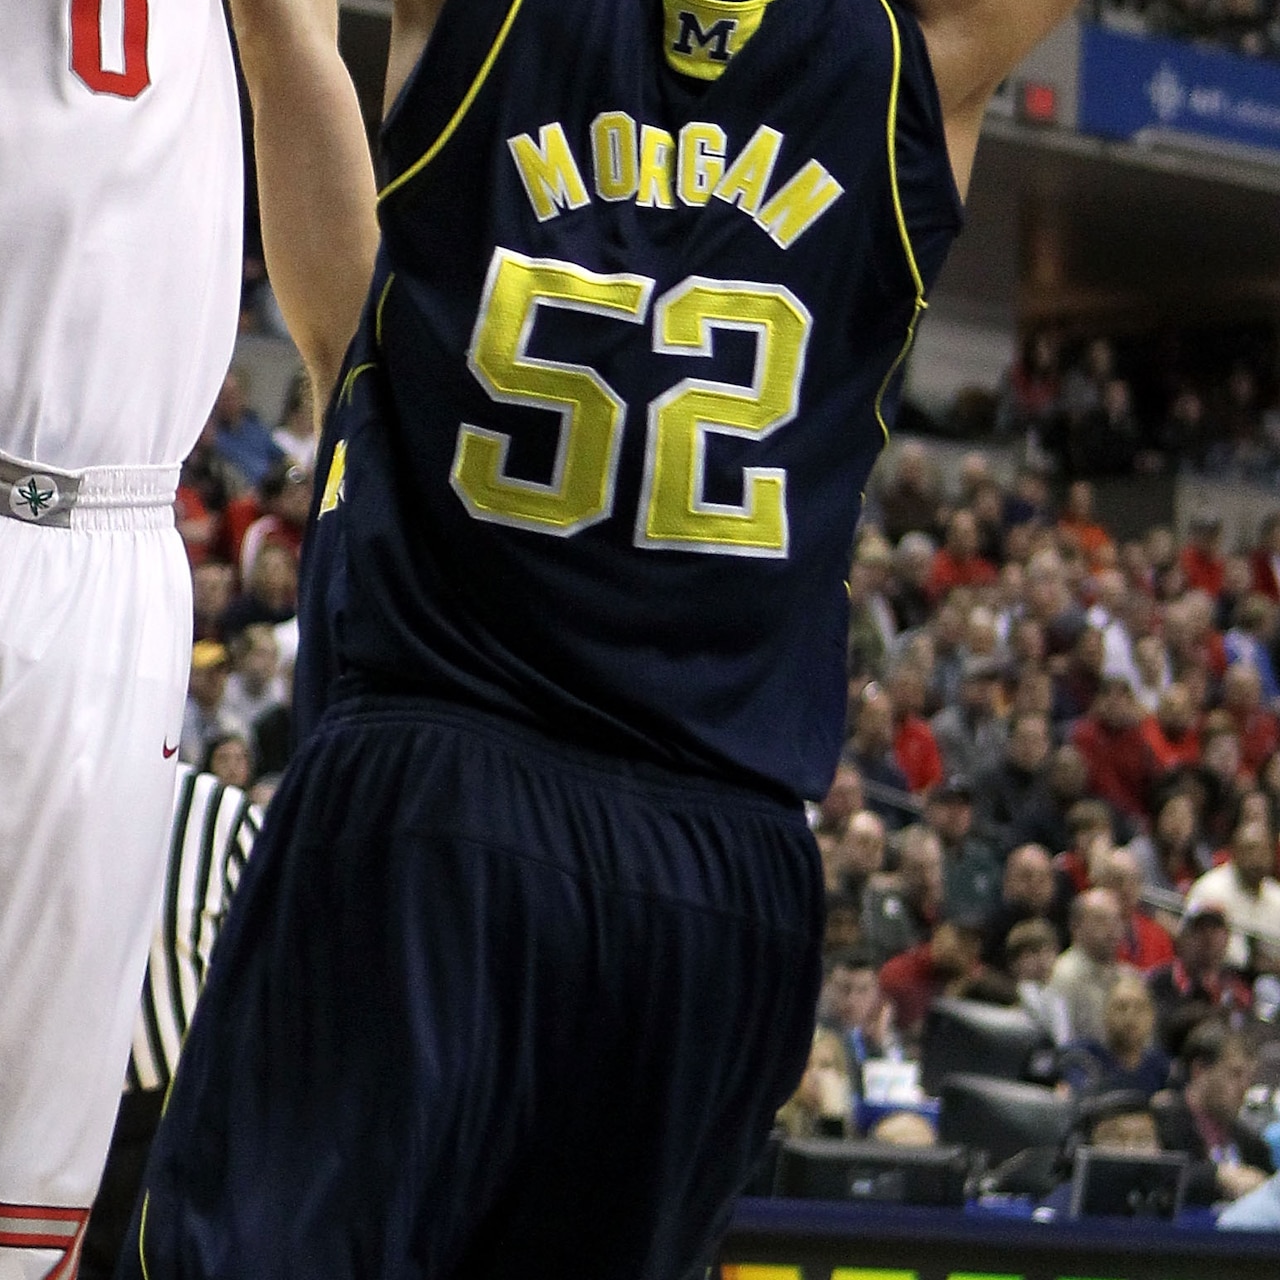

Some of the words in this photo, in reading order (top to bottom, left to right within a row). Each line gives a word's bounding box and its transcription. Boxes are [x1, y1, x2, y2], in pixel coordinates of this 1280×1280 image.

[672, 10, 737, 62] M
[506, 110, 845, 251] MORGAN
[449, 245, 814, 560] 52
